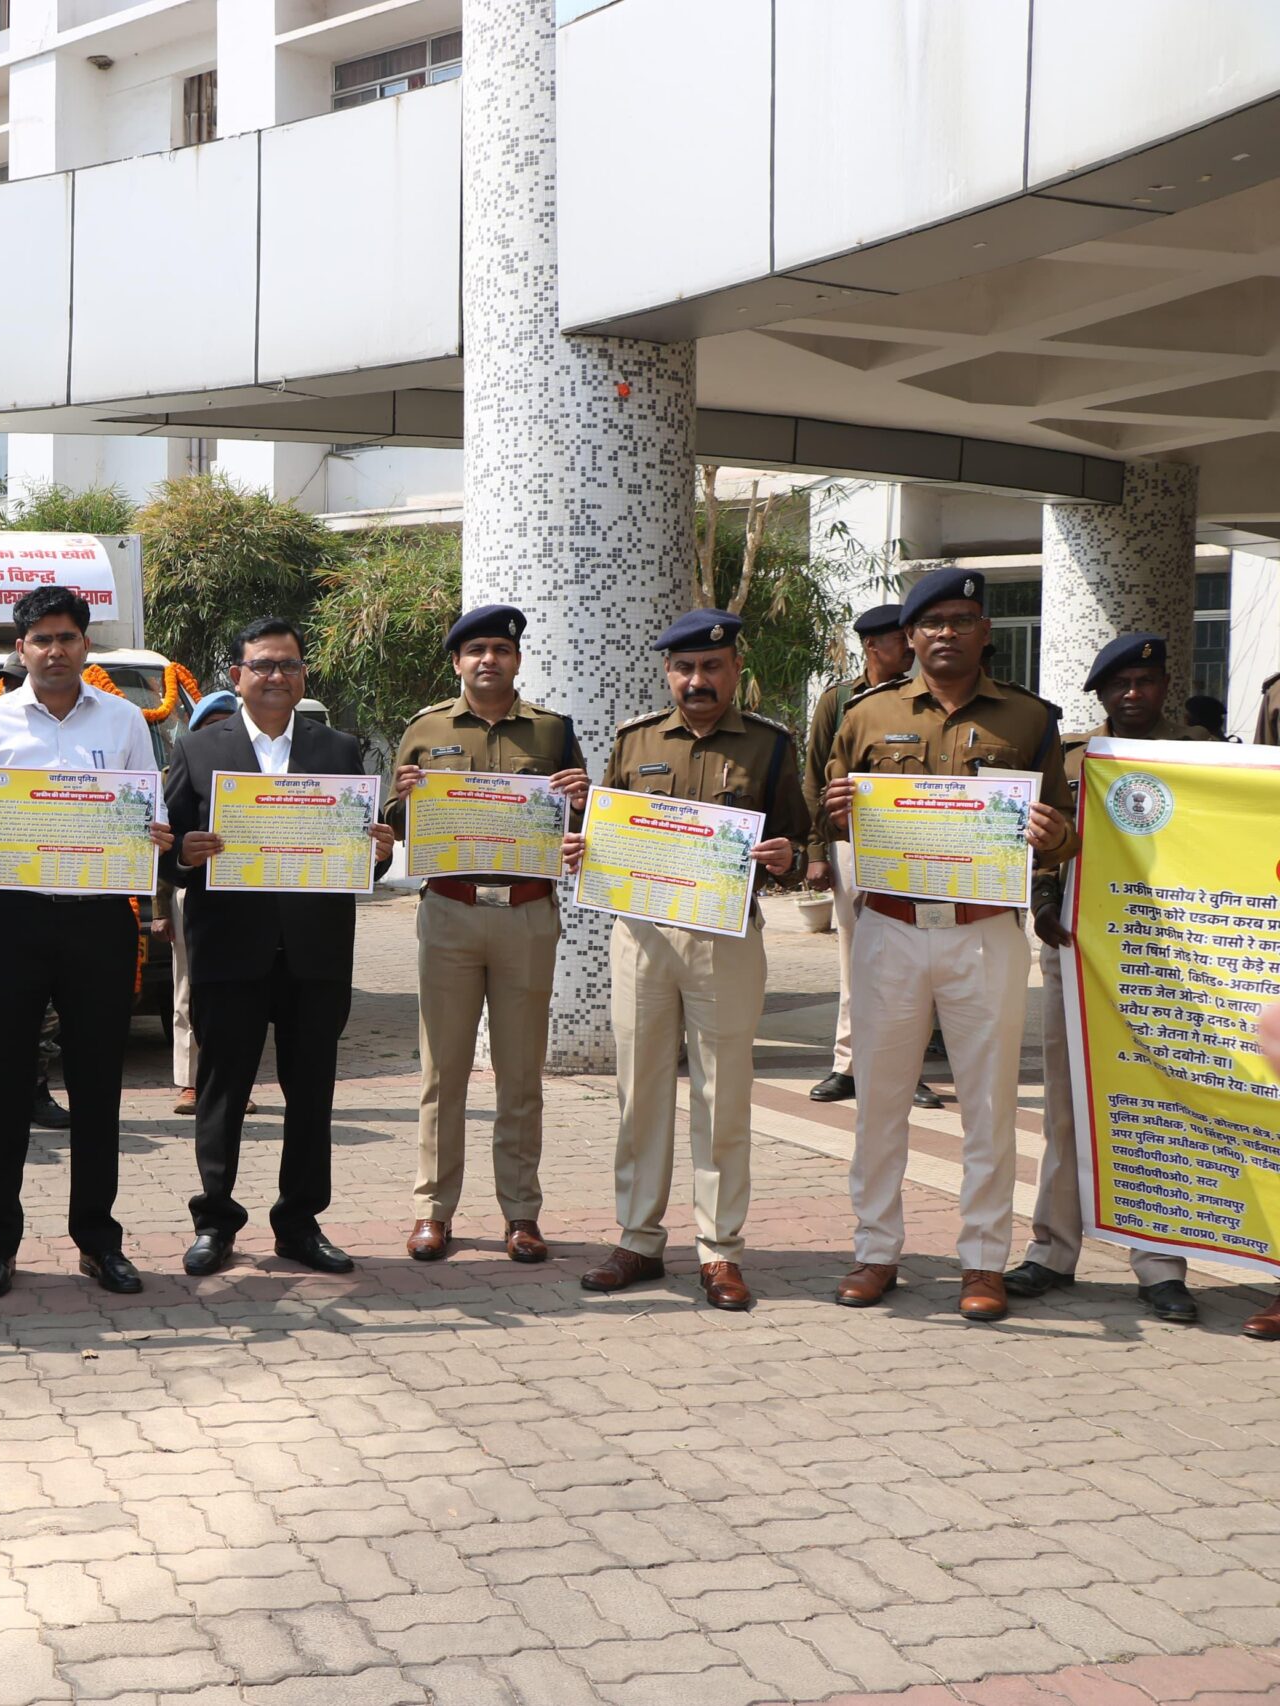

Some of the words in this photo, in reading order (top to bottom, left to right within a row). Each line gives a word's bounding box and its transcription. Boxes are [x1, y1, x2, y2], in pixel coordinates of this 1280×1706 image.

[8, 567, 55, 583] विरुद्ध
[78, 774, 97, 784] पुलिस
[945, 782, 966, 791] पुलिस
[1110, 883, 1119, 893] 1.
[1123, 883, 1152, 896] अफीम
[1156, 888, 1195, 902] चासोय
[1200, 889, 1206, 902] रे
[1246, 896, 1277, 909] चासो
[1164, 908, 1185, 921] कोरे
[1190, 913, 1229, 925] एडकन
[1108, 923, 1119, 933] 2.
[1123, 921, 1151, 935] अवैध
[1155, 927, 1183, 941] अफीम
[1213, 935, 1244, 948] चासो
[1248, 936, 1255, 948] रे
[1122, 941, 1142, 954] गेल
[1217, 957, 1238, 972] एसु
[1156, 985, 1176, 999] जेल
[1119, 1001, 1148, 1016] अवैध
[1186, 1012, 1204, 1027] उकु
[1157, 1026, 1188, 1040] जेतना
[1154, 1045, 1169, 1058] को
[1191, 1071, 1224, 1087] अफीम
[1108, 1094, 1138, 1107] पुलिस
[1214, 1118, 1249, 1133] कोल्हान
[1109, 1111, 1139, 1123] पुलिस
[1142, 1116, 1186, 1131] अधीक्षक,
[1111, 1129, 1132, 1138] अपर
[1135, 1131, 1164, 1144] पुलिस
[1168, 1137, 1209, 1150] अधीक्षक
[1196, 1159, 1240, 1178] चक्रधरपुर
[1196, 1176, 1218, 1187] सदर
[1196, 1211, 1240, 1229] मनोहरपुर
[1153, 1222, 1169, 1233] सह
[1222, 1234, 1268, 1252] चक्रधरपुर
